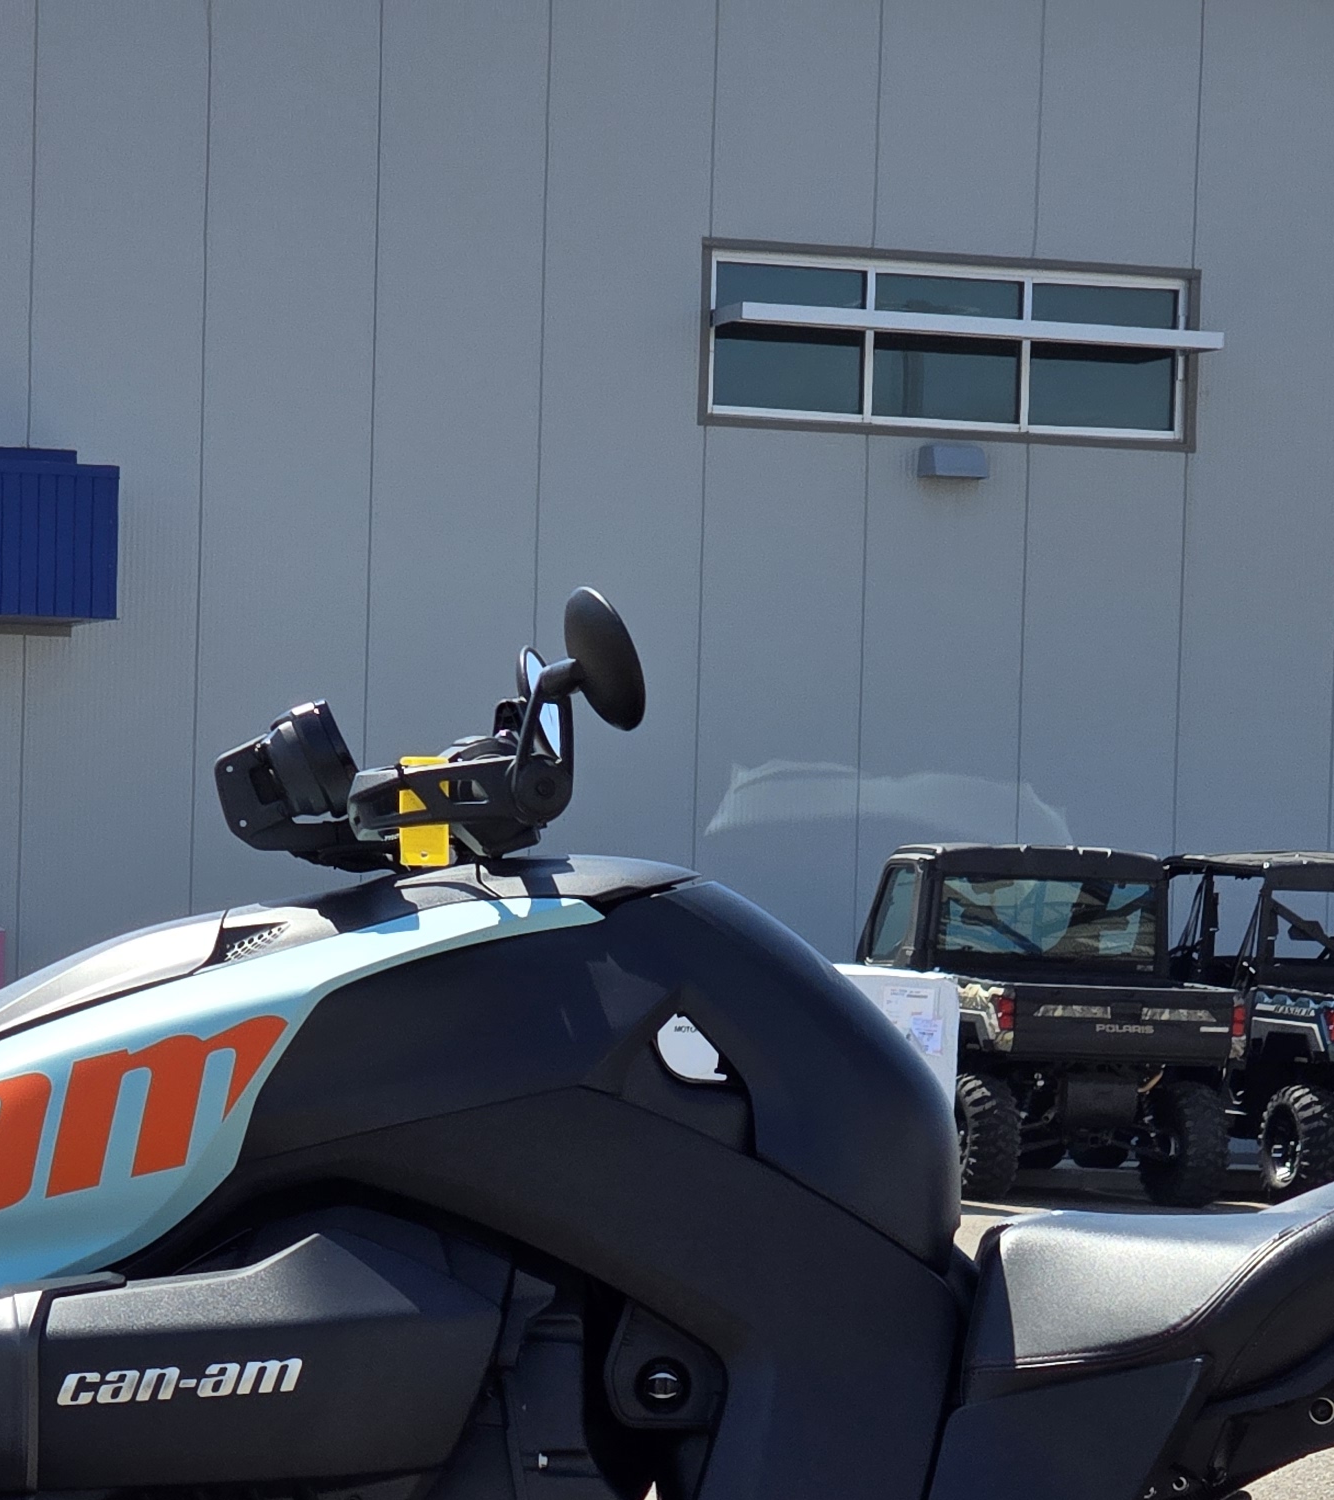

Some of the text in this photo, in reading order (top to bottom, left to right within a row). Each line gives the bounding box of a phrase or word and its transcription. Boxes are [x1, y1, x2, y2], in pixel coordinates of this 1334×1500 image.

[1273, 1005, 1314, 1016] RANGER
[1095, 1024, 1154, 1034] POLARIS
[57, 1358, 303, 1406] can-am
